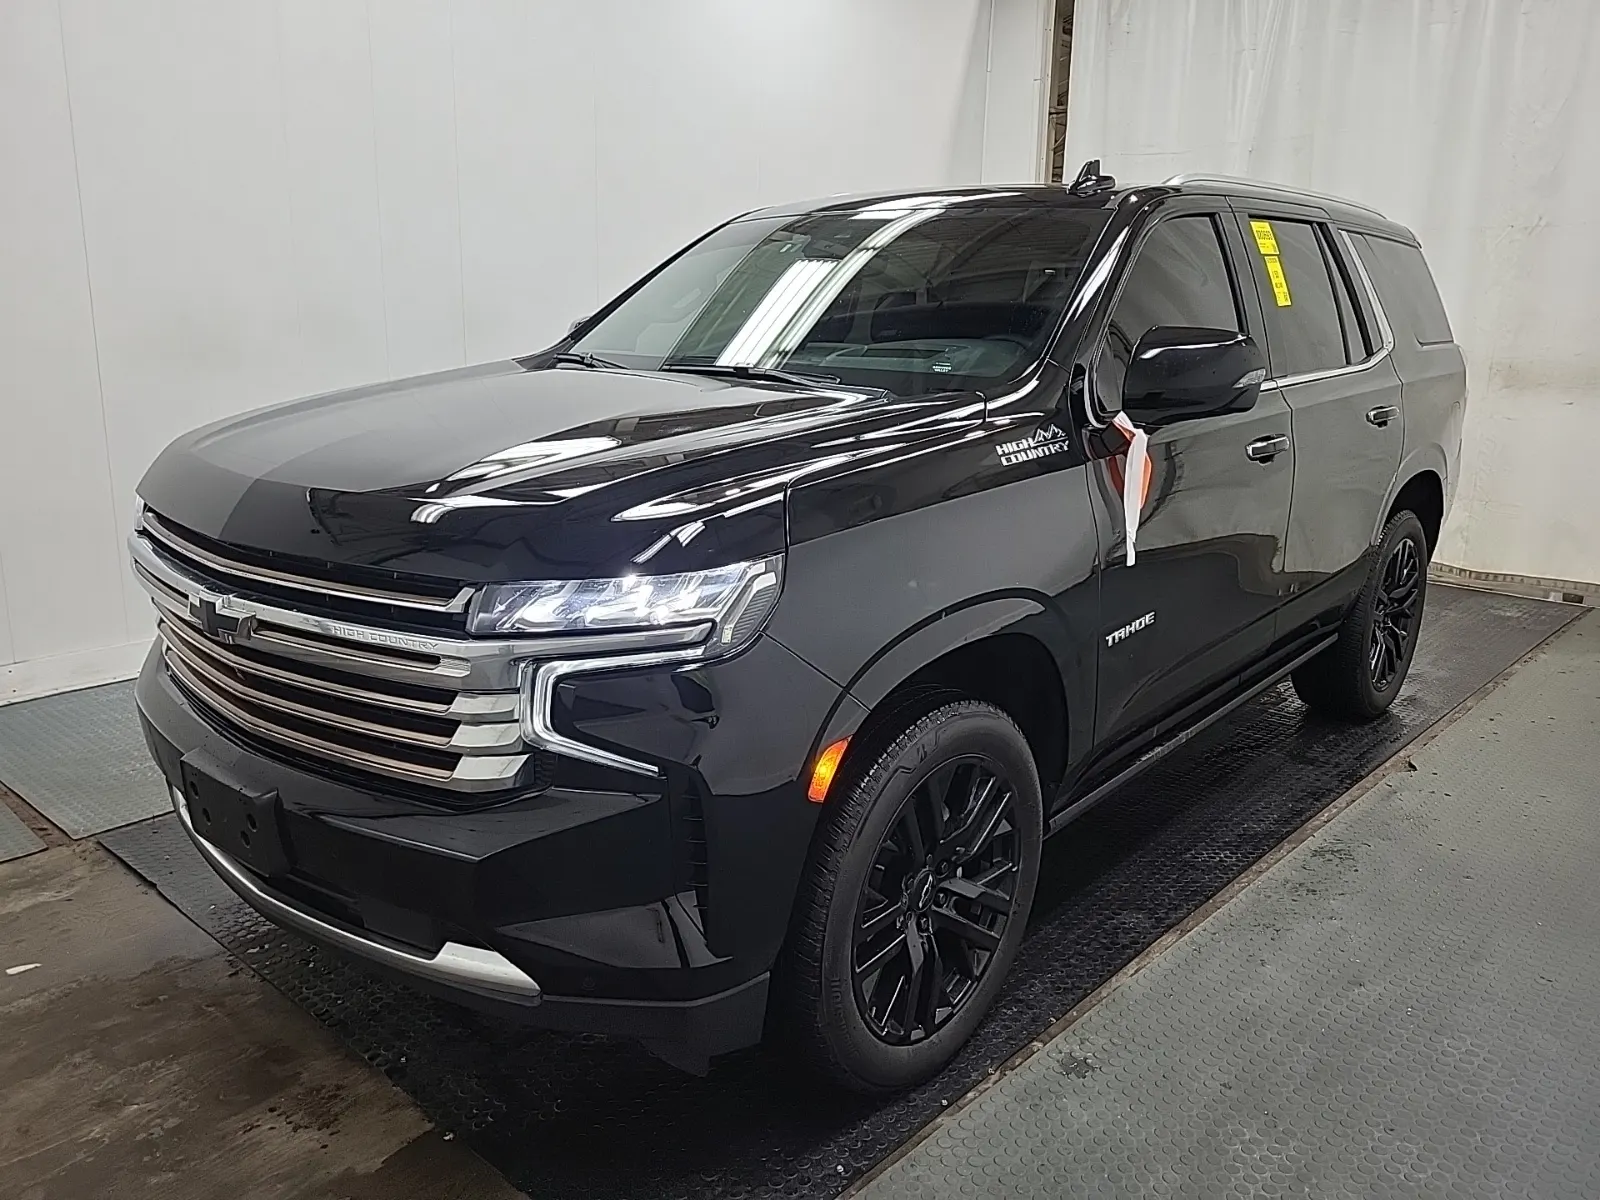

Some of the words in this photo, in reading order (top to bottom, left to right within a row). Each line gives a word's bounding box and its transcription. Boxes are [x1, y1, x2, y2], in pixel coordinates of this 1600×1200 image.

[995, 437, 1034, 455] HIGH
[1000, 440, 1069, 466] COUNTRY
[332, 625, 364, 639] HIGH
[370, 633, 438, 650] COUNTRY
[1105, 611, 1155, 647] TAHOE
